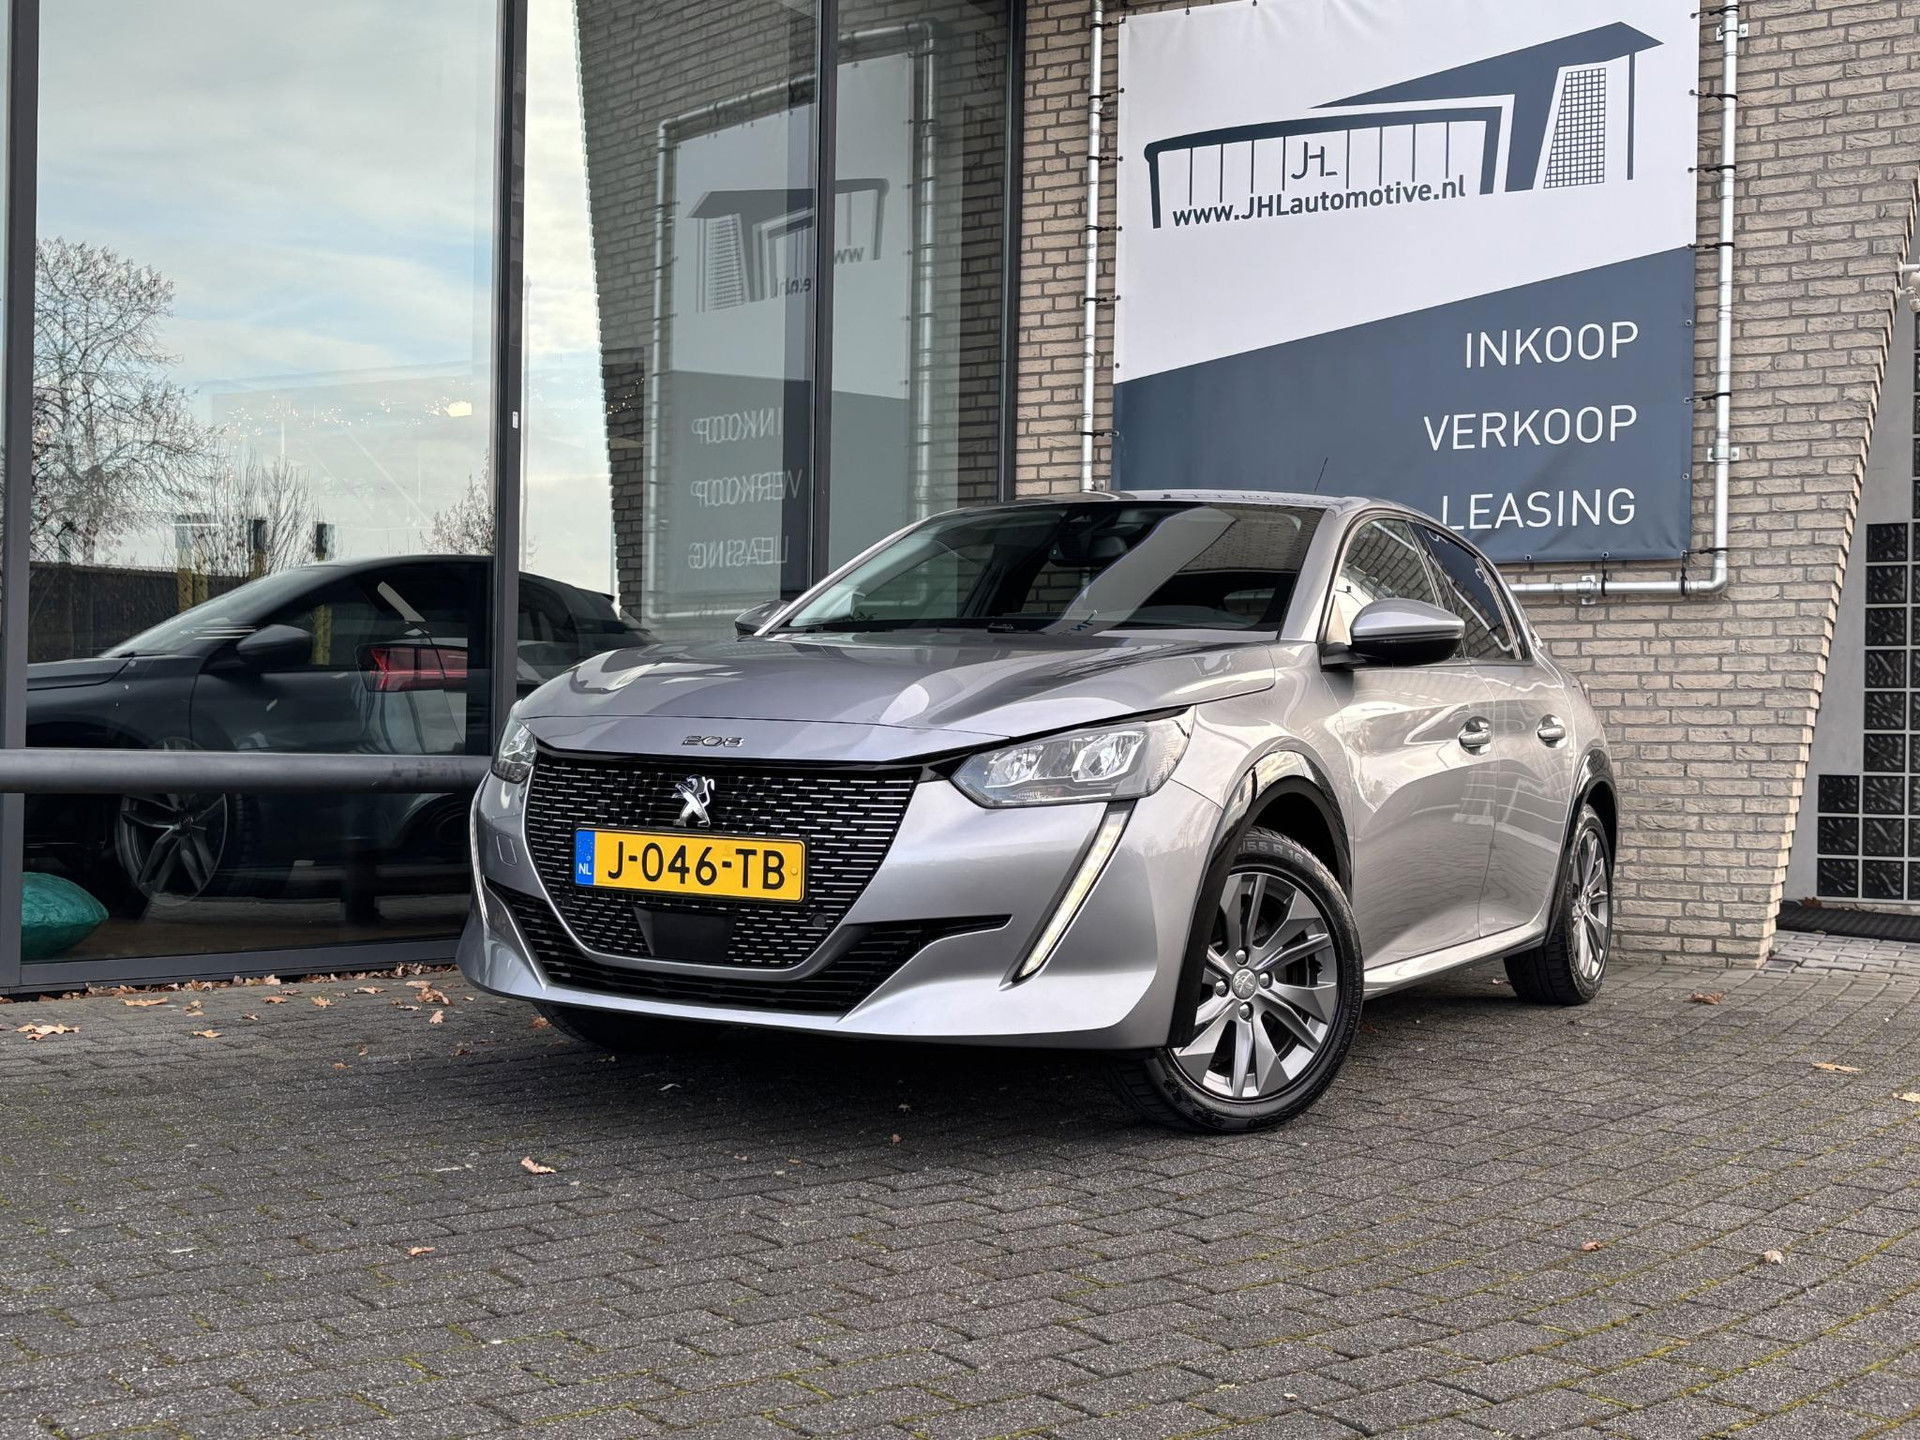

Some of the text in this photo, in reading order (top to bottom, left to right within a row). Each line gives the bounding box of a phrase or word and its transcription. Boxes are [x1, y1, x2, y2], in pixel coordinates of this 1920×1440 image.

[1291, 141, 1338, 180] JHL
[1172, 174, 1466, 227] www.JHLautomotive.nl
[1465, 321, 1639, 369] INKOOP
[1424, 404, 1638, 451] VERKOOP
[1442, 487, 1636, 531] LEASING
[578, 862, 593, 876] NL
[607, 840, 786, 891] J-046-TB
